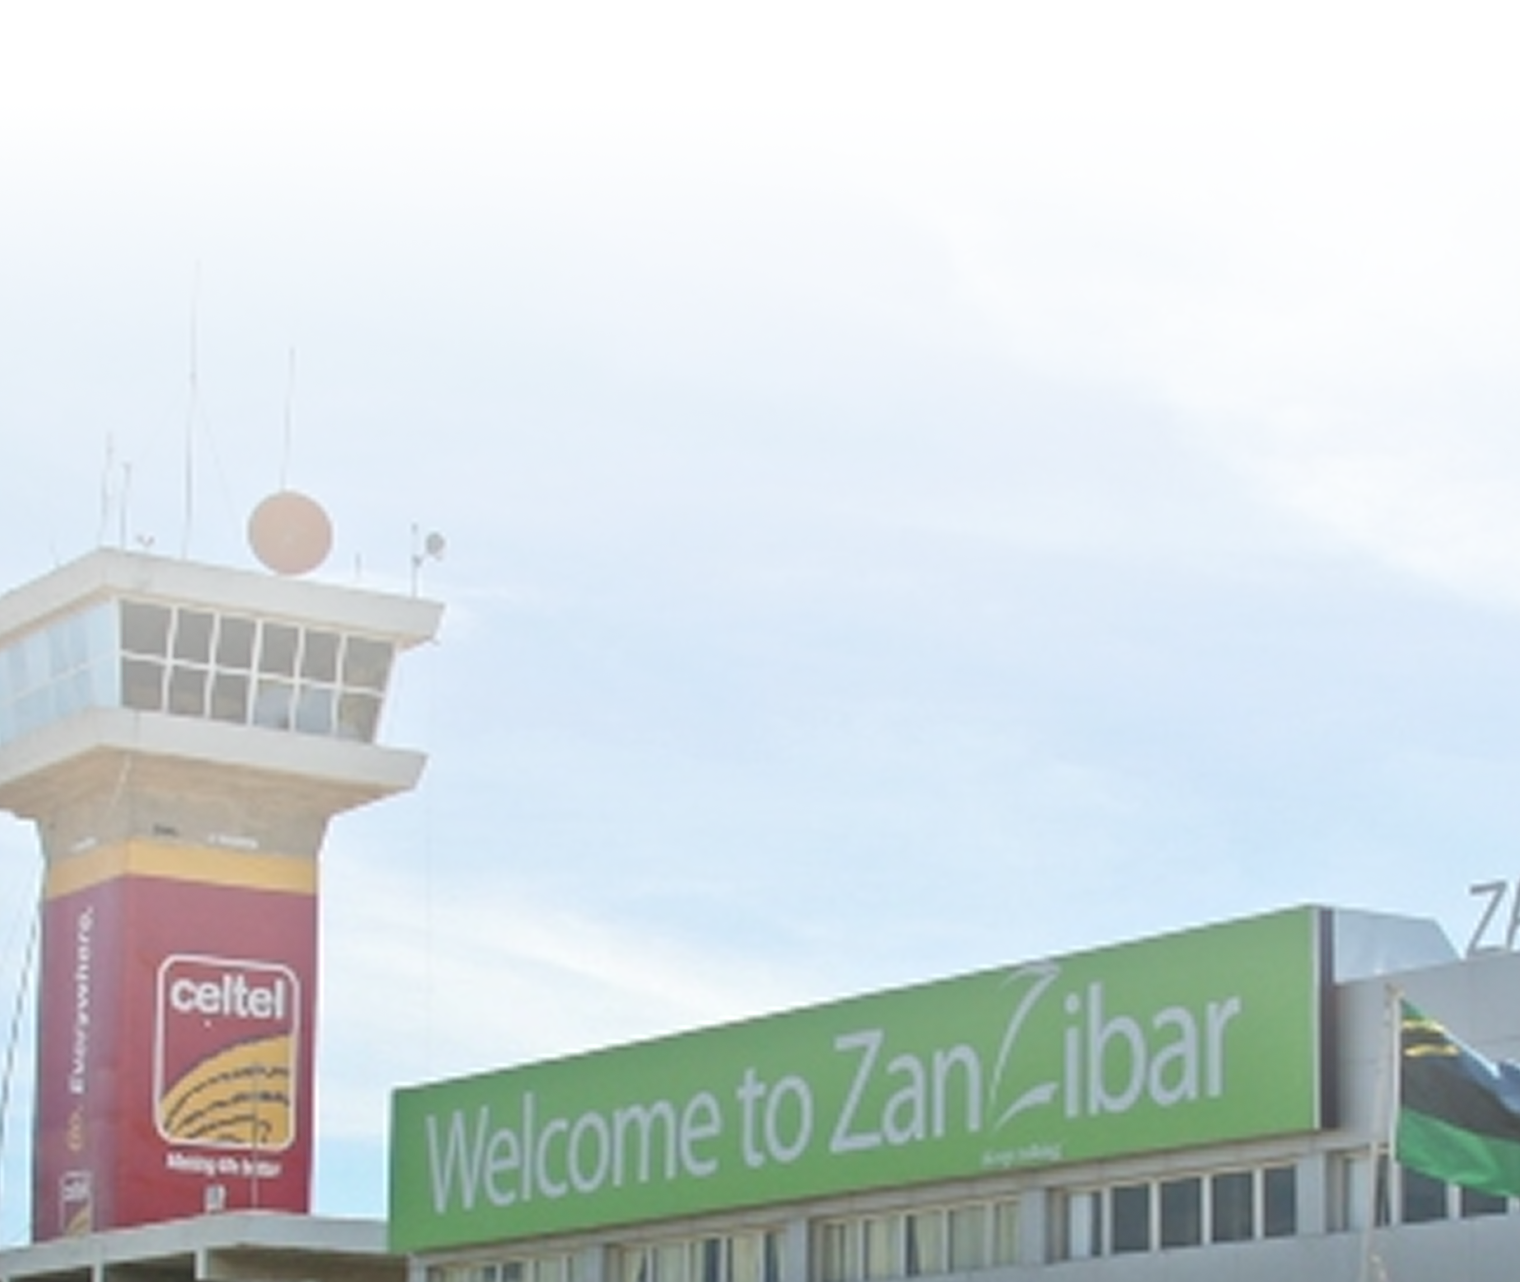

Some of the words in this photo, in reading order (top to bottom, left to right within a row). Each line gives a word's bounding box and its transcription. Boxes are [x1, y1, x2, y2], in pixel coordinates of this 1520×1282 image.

[170, 974, 285, 1020] celtel
[426, 1091, 723, 1213] Welcome
[737, 1067, 813, 1168] to
